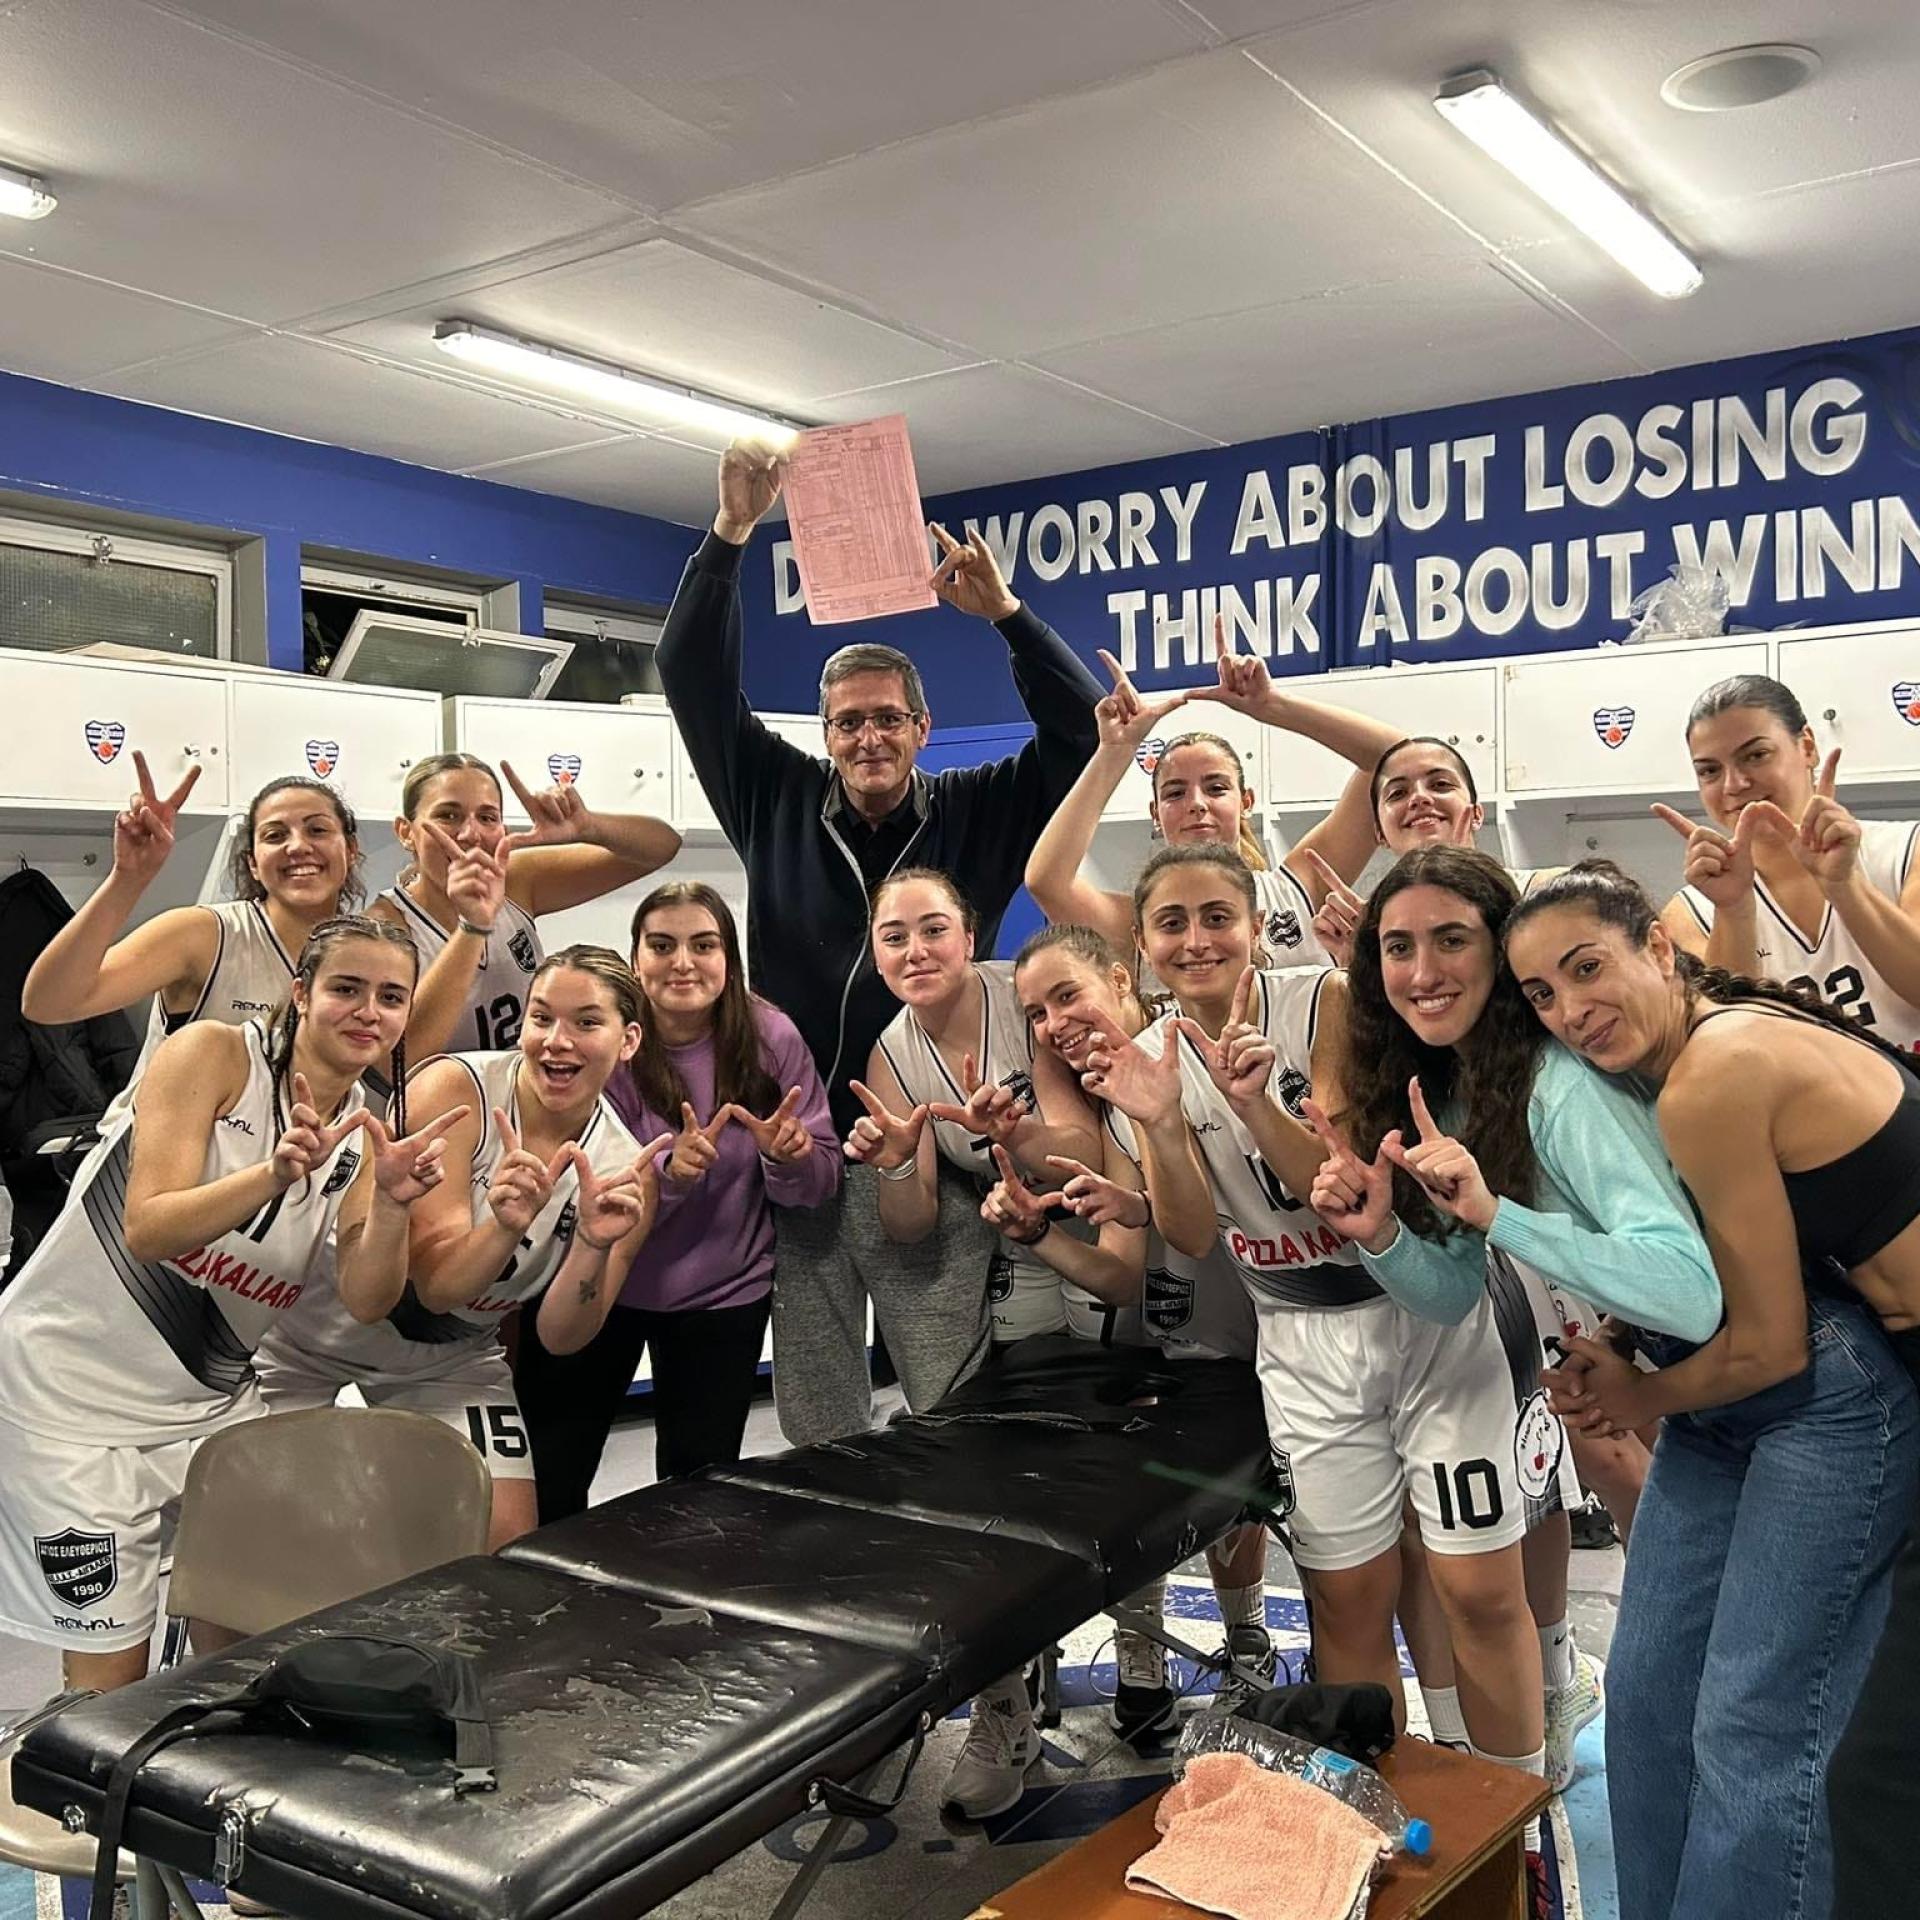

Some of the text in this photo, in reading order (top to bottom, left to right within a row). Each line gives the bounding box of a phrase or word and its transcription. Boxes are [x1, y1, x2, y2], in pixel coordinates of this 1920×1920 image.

[963, 480, 1208, 585] WORRY
[1230, 433, 1496, 557] ABOUT
[1524, 377, 1867, 512] LOSING
[1107, 573, 1321, 672] THINK
[1357, 530, 1645, 649] ABOUT
[475, 993, 521, 1050] 12
[465, 1405, 528, 1459] 15
[1433, 1458, 1504, 1530] 10
[72, 1582, 103, 1597] 1990
